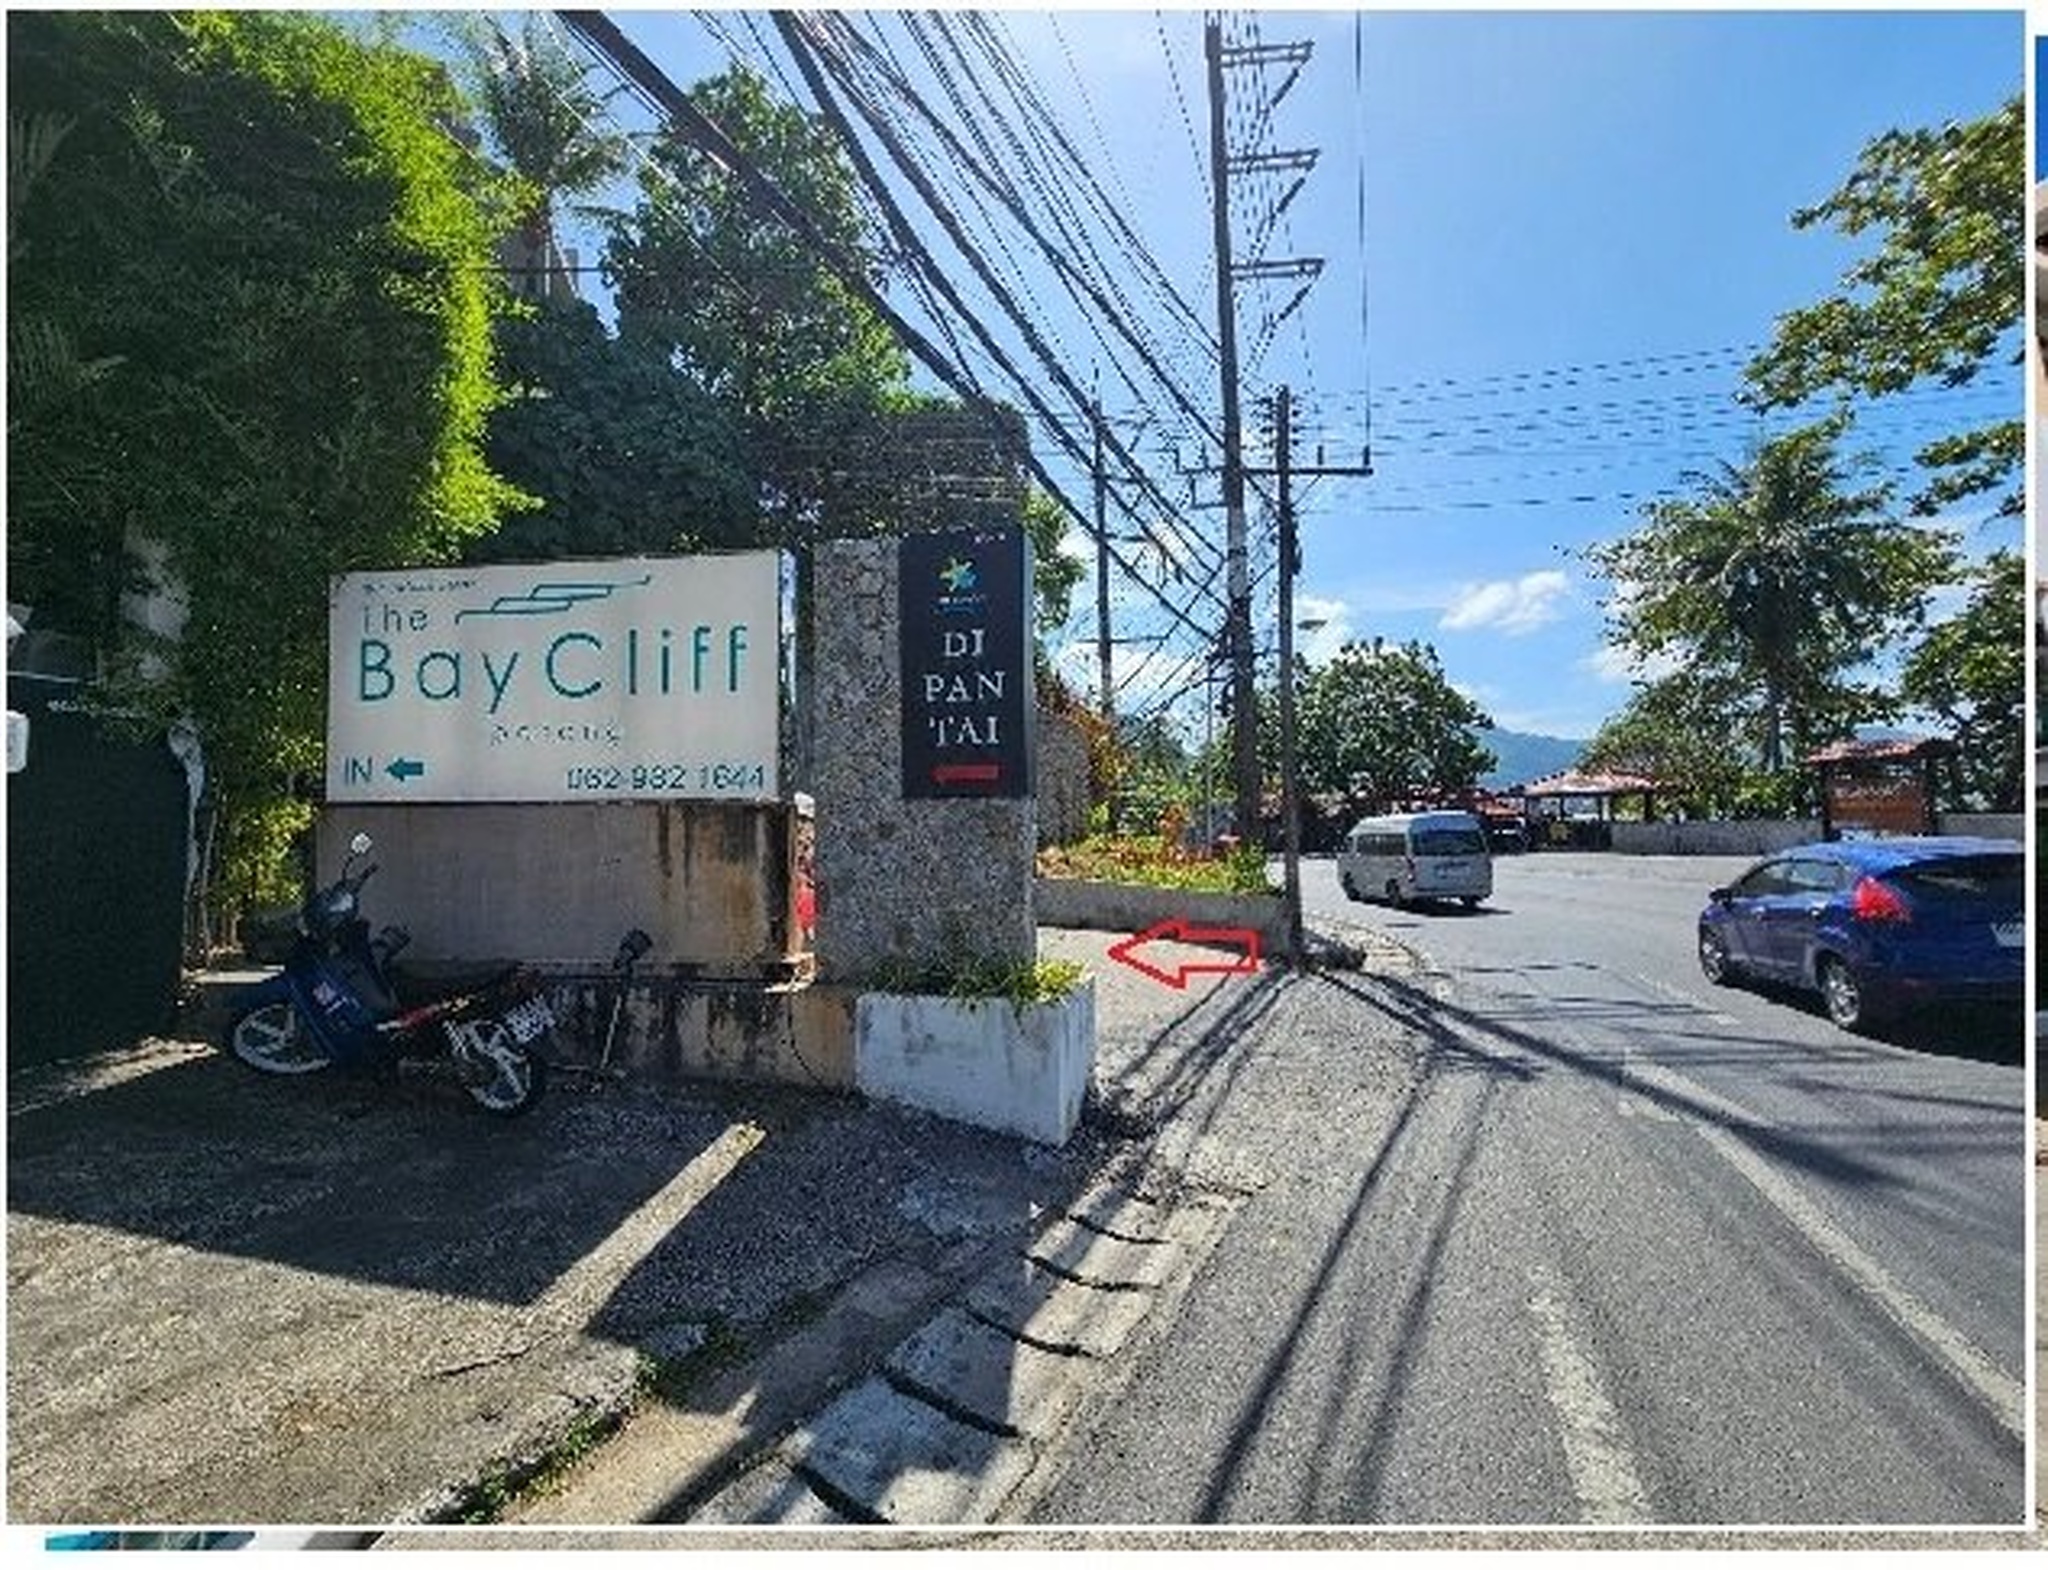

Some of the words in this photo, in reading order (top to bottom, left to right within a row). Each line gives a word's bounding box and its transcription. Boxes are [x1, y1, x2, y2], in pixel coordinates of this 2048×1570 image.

[944, 628, 985, 658] DI
[359, 637, 520, 714] Bay
[545, 625, 749, 699] Cliff
[922, 671, 1006, 702] PAN
[928, 715, 1000, 747] TAI
[343, 757, 374, 786] IN
[567, 765, 622, 790] 062
[700, 763, 766, 790] 1644
